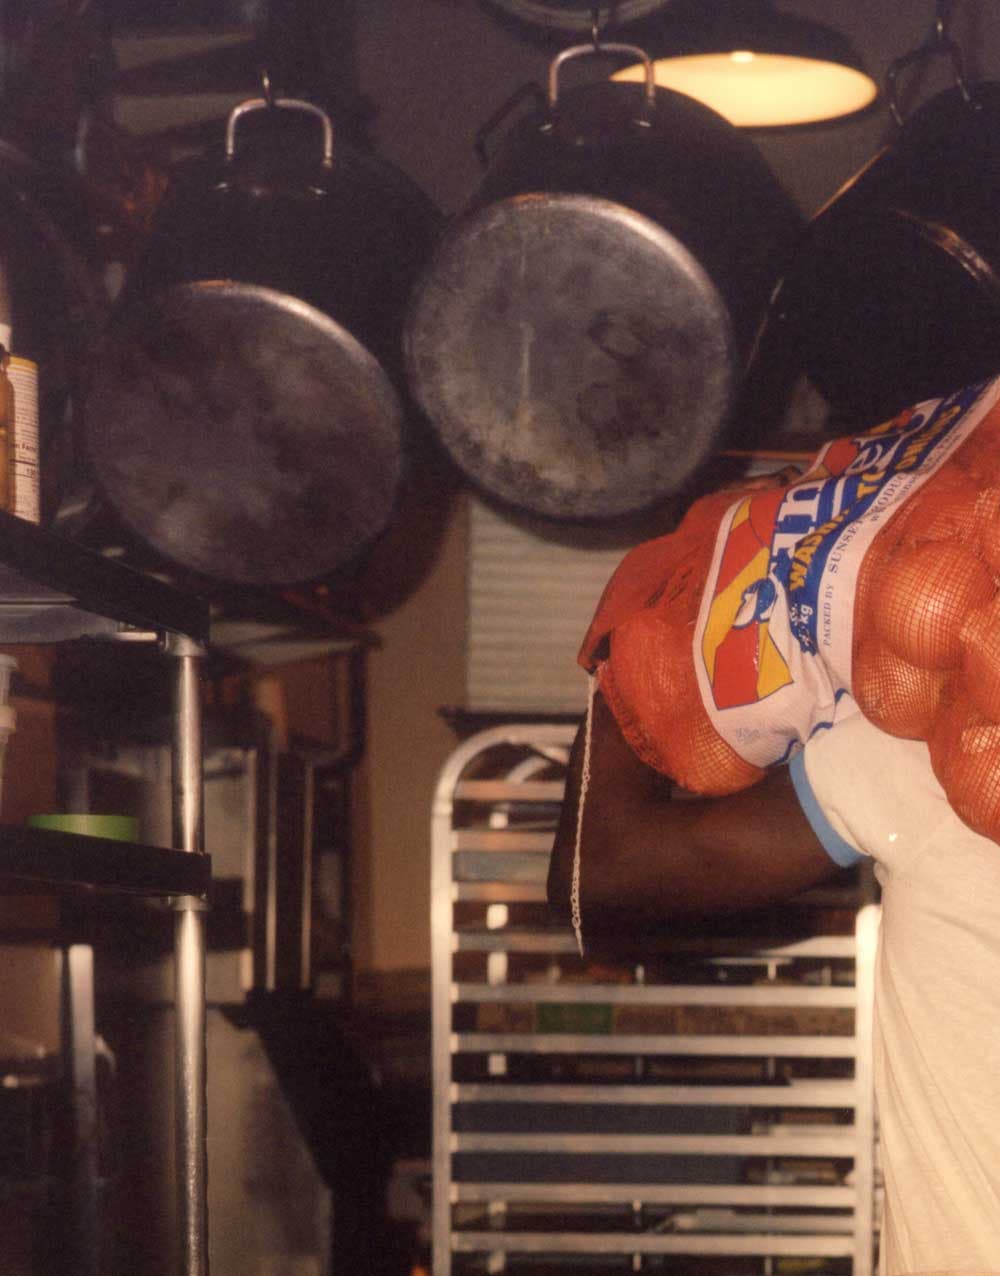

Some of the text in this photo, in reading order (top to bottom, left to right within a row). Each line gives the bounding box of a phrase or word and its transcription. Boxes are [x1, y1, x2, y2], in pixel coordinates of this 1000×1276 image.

[824, 585, 834, 599] BY
[800, 603, 814, 624] kg
[823, 603, 832, 646] PACKED
